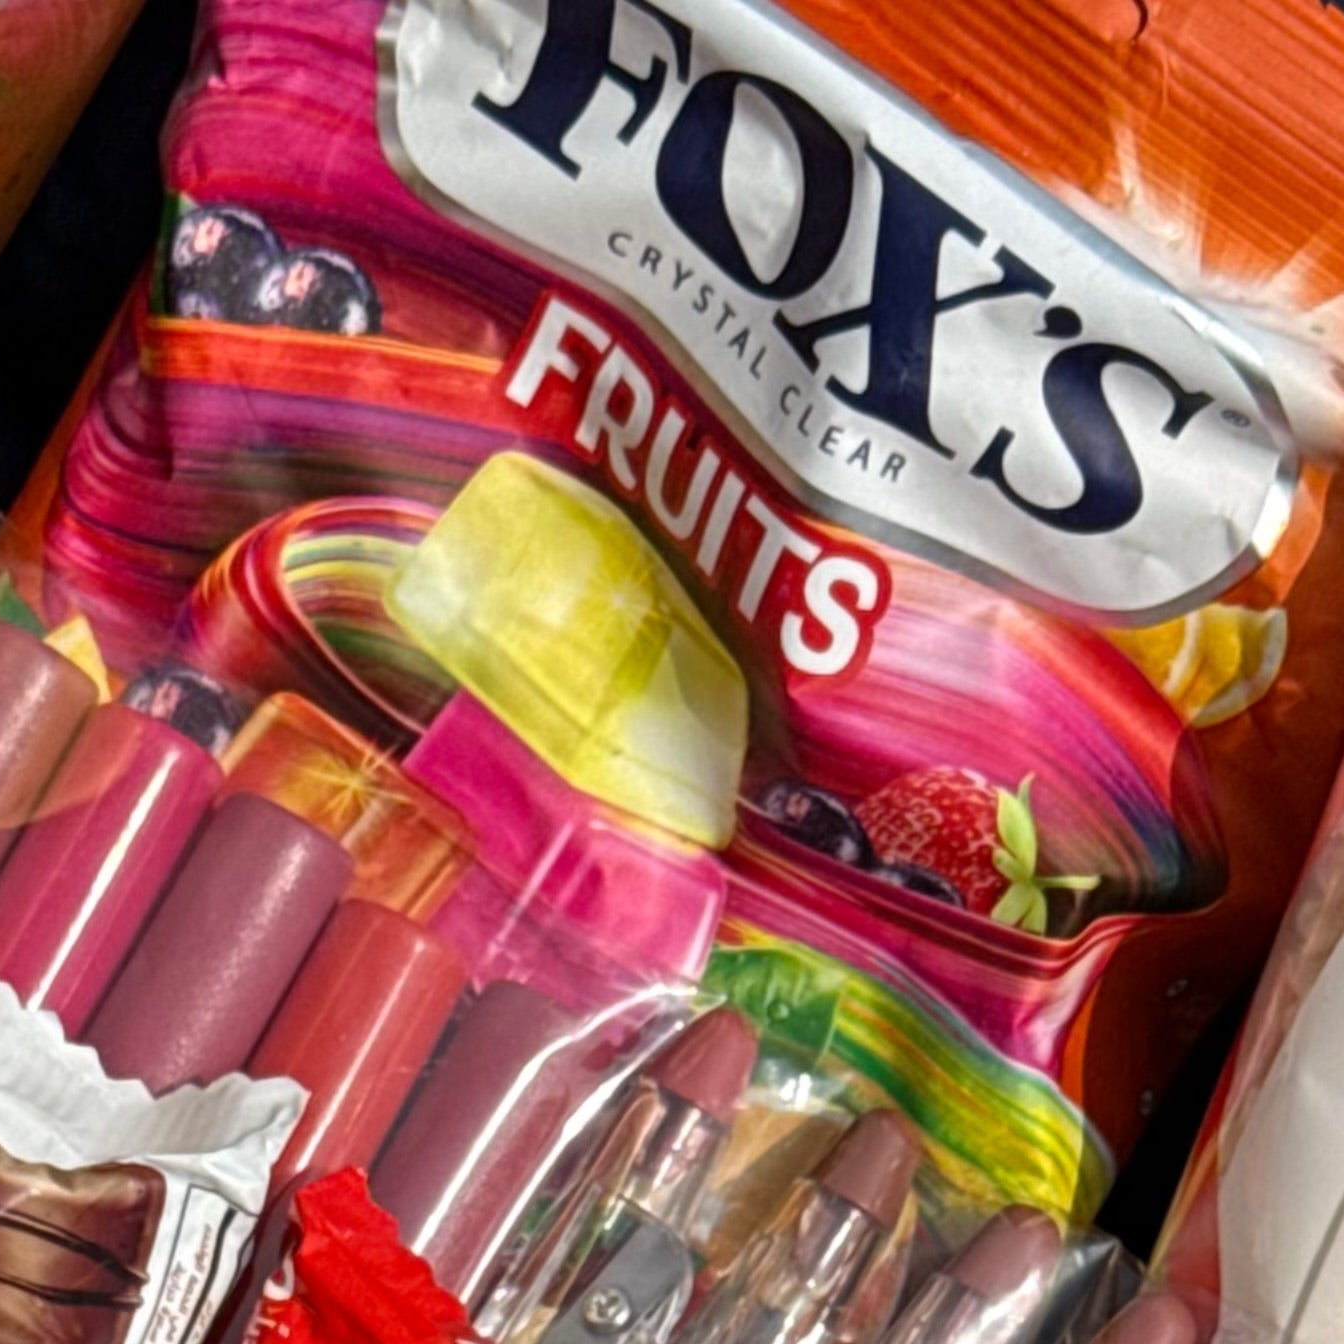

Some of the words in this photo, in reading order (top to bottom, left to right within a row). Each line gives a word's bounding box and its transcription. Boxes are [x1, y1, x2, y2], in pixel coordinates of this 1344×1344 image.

[473, 0, 1212, 535] FOX'S
[607, 229, 770, 380] CRYSTAL
[778, 386, 906, 484] CLEAR
[504, 298, 880, 677] FRUITS
